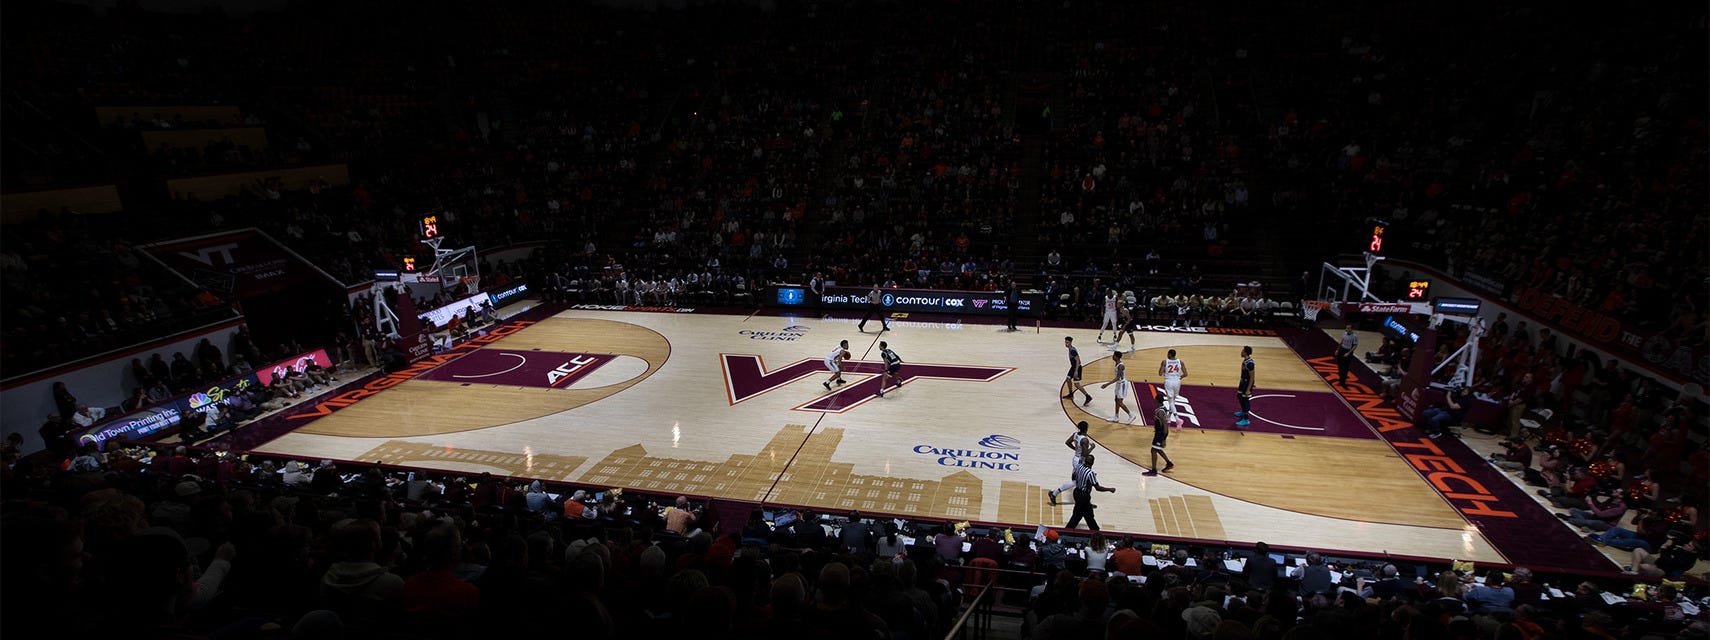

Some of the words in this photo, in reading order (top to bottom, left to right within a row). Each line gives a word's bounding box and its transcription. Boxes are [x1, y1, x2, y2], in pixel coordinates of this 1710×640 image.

[425, 224, 437, 237] 24
[1370, 235, 1382, 251] 24
[821, 294, 848, 304] irginia
[1409, 288, 1423, 297] 24
[1518, 287, 1622, 343] DEFEND
[286, 352, 466, 420] VIRGINIA
[450, 320, 537, 352] TECH
[547, 354, 595, 385] ACC
[1167, 365, 1180, 373] 24
[718, 352, 1018, 414] VT
[105, 425, 132, 438] Town
[129, 413, 164, 430] Printing
[912, 445, 1019, 460] CARILION
[937, 456, 1020, 471] CLINIC
[1391, 437, 1520, 518] TECH
